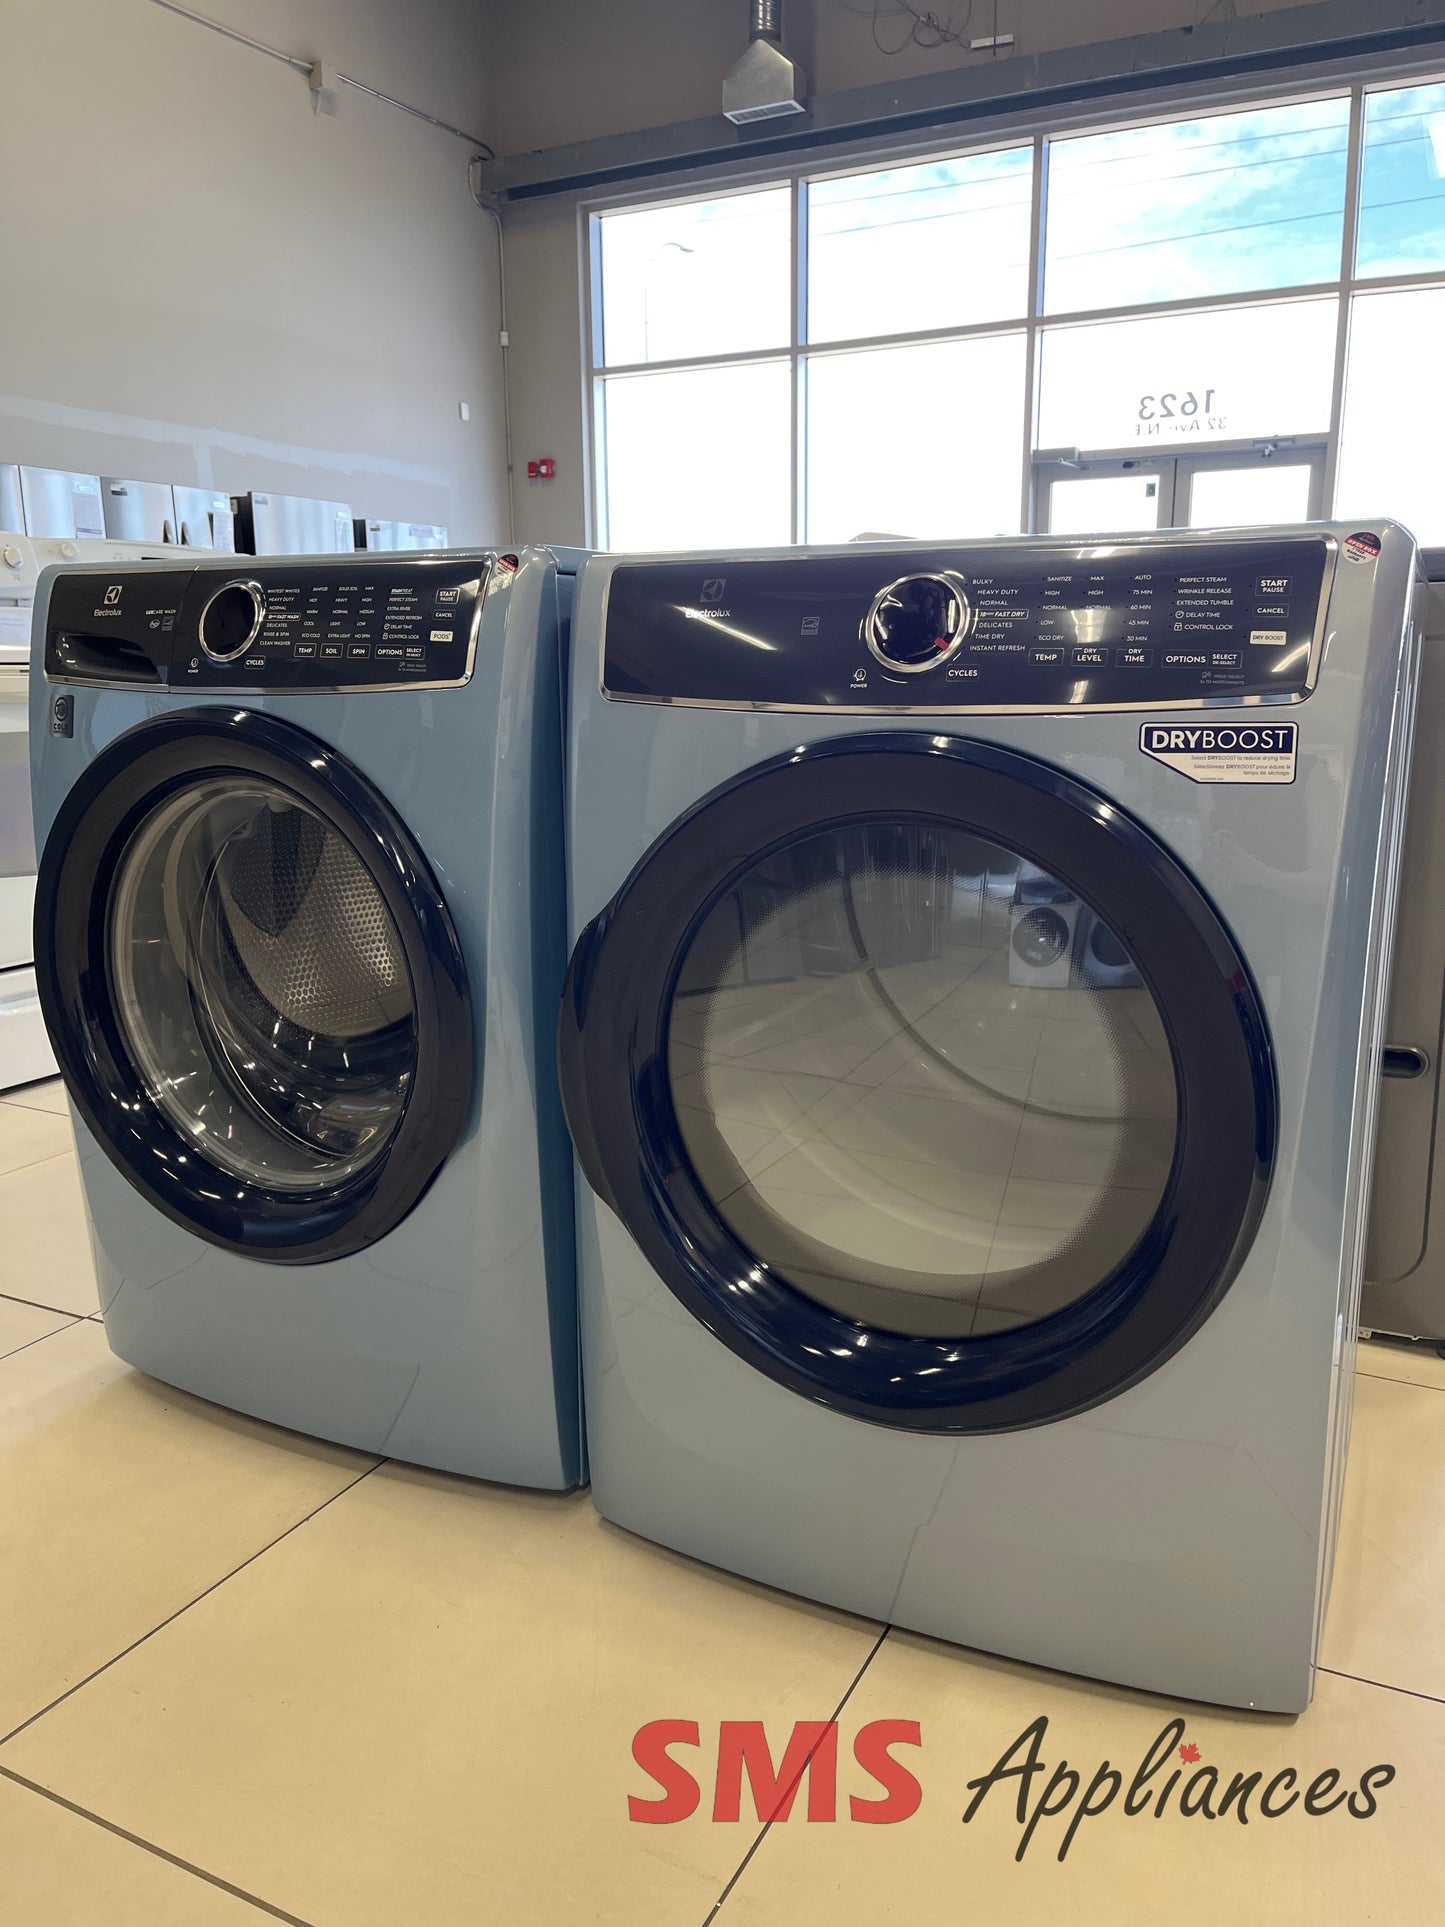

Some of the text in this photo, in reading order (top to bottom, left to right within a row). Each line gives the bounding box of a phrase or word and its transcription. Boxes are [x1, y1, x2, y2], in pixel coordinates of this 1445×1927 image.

[1348, 539, 1363, 549] OPEN
[1363, 546, 1377, 556] BOX
[94, 609, 122, 617] Electrolux
[685, 607, 731, 618] Electrolux
[1152, 730, 1288, 749] DRYBOOST
[1262, 755, 1279, 763] drying
